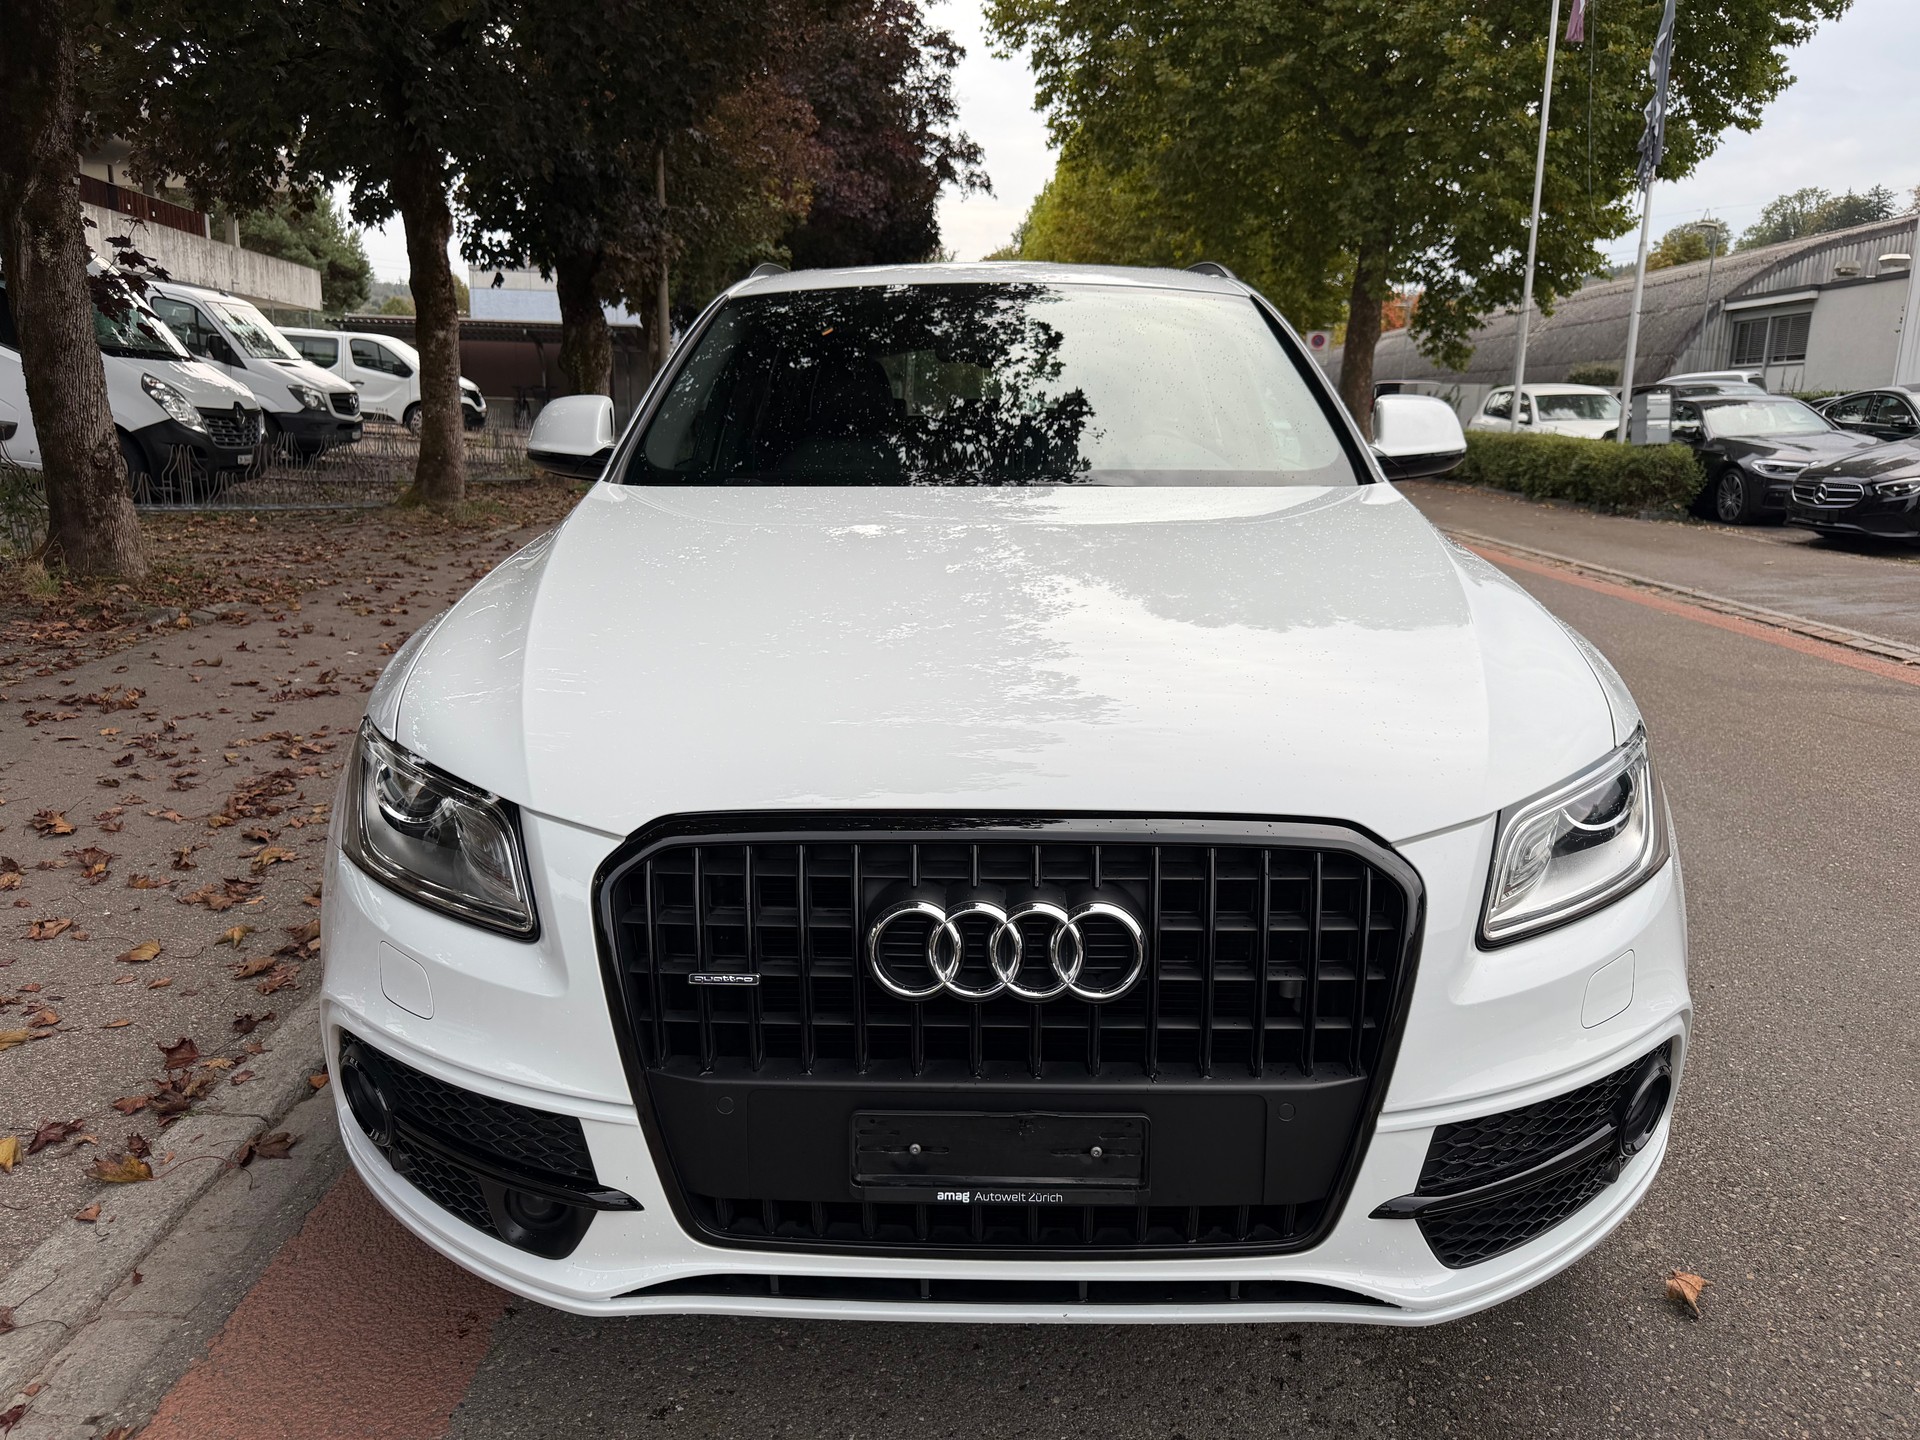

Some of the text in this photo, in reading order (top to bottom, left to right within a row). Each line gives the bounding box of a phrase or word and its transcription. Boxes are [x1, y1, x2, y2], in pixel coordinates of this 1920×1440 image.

[694, 975, 754, 984] quattro
[937, 1191, 1063, 1203] amag Autowelt Zürich
